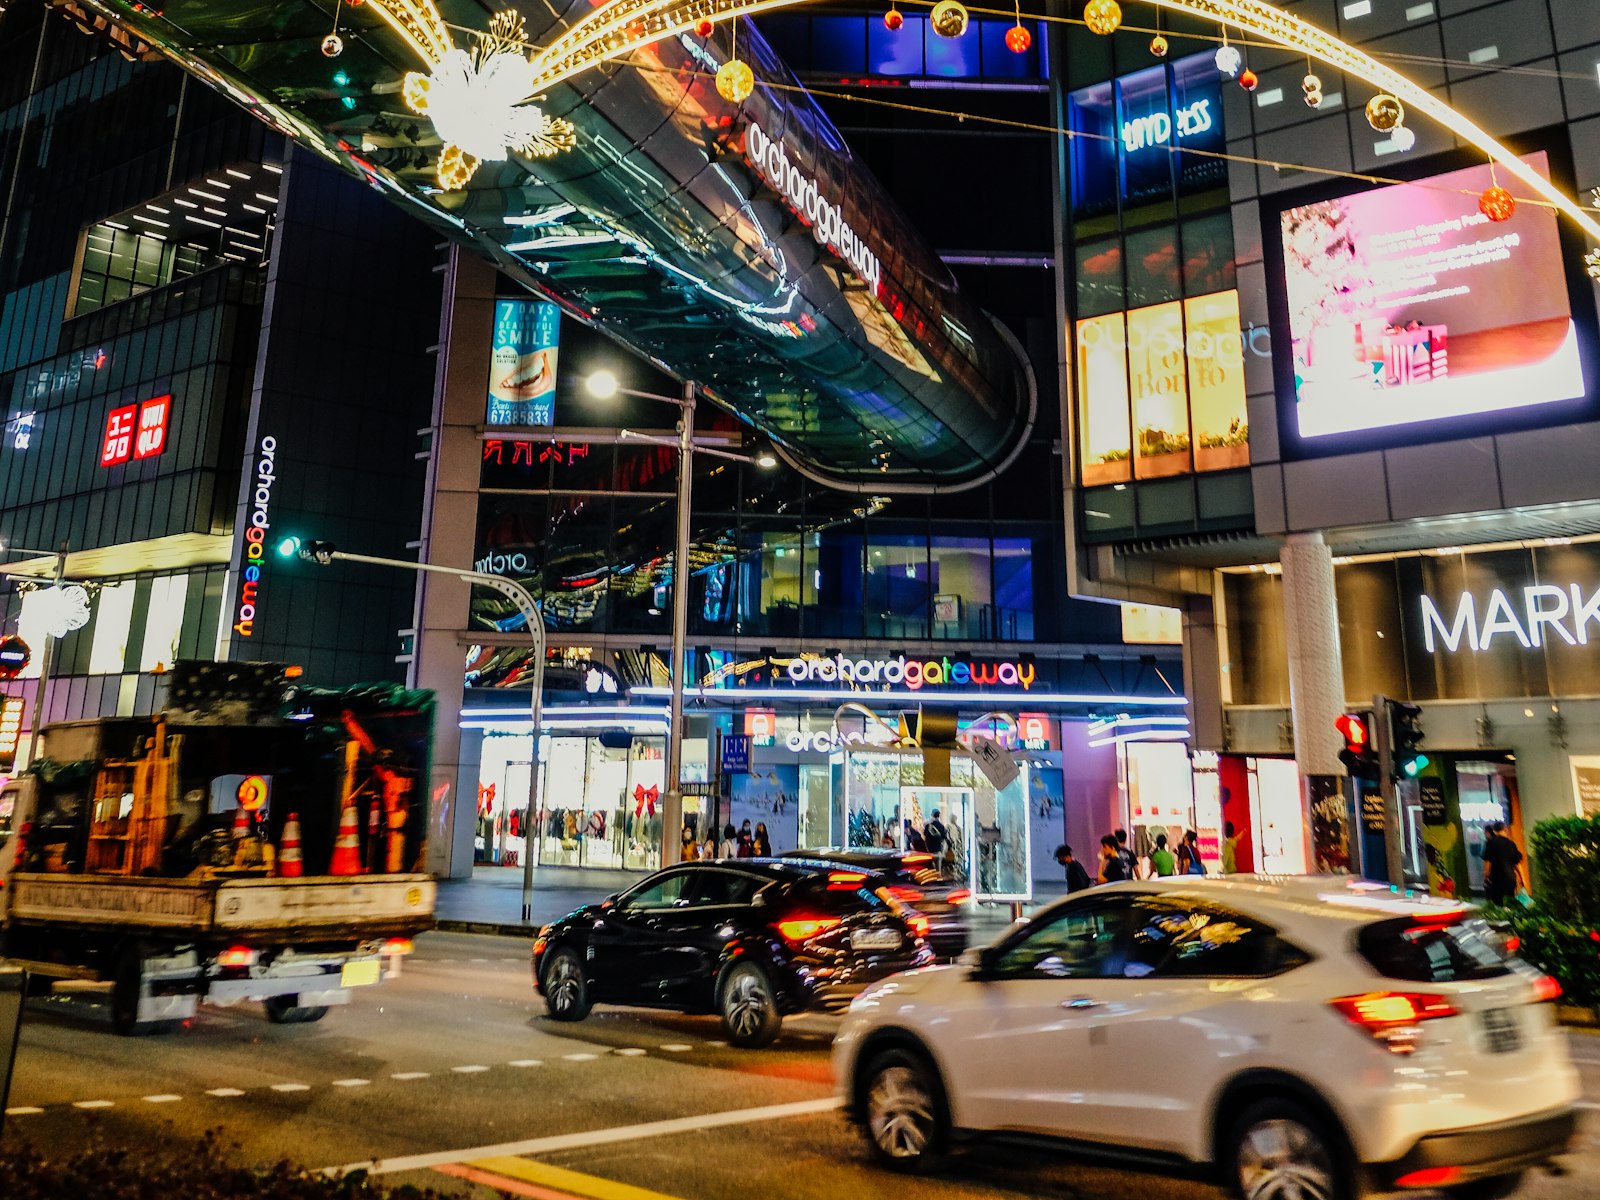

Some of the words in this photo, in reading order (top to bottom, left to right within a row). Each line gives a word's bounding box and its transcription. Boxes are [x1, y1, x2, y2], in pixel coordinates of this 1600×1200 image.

[750, 122, 880, 297] orchardgateway
[501, 303, 514, 321] 7
[519, 304, 553, 316] DAYS
[497, 330, 552, 345] SMILE
[499, 321, 553, 331] BEAUTIFUL
[142, 403, 165, 429] UNI
[491, 410, 549, 426] 67385833
[138, 427, 163, 456] QLO
[234, 435, 276, 637] orchardgateway
[1420, 583, 1600, 653] MARK
[788, 652, 1035, 690] orchardgateway
